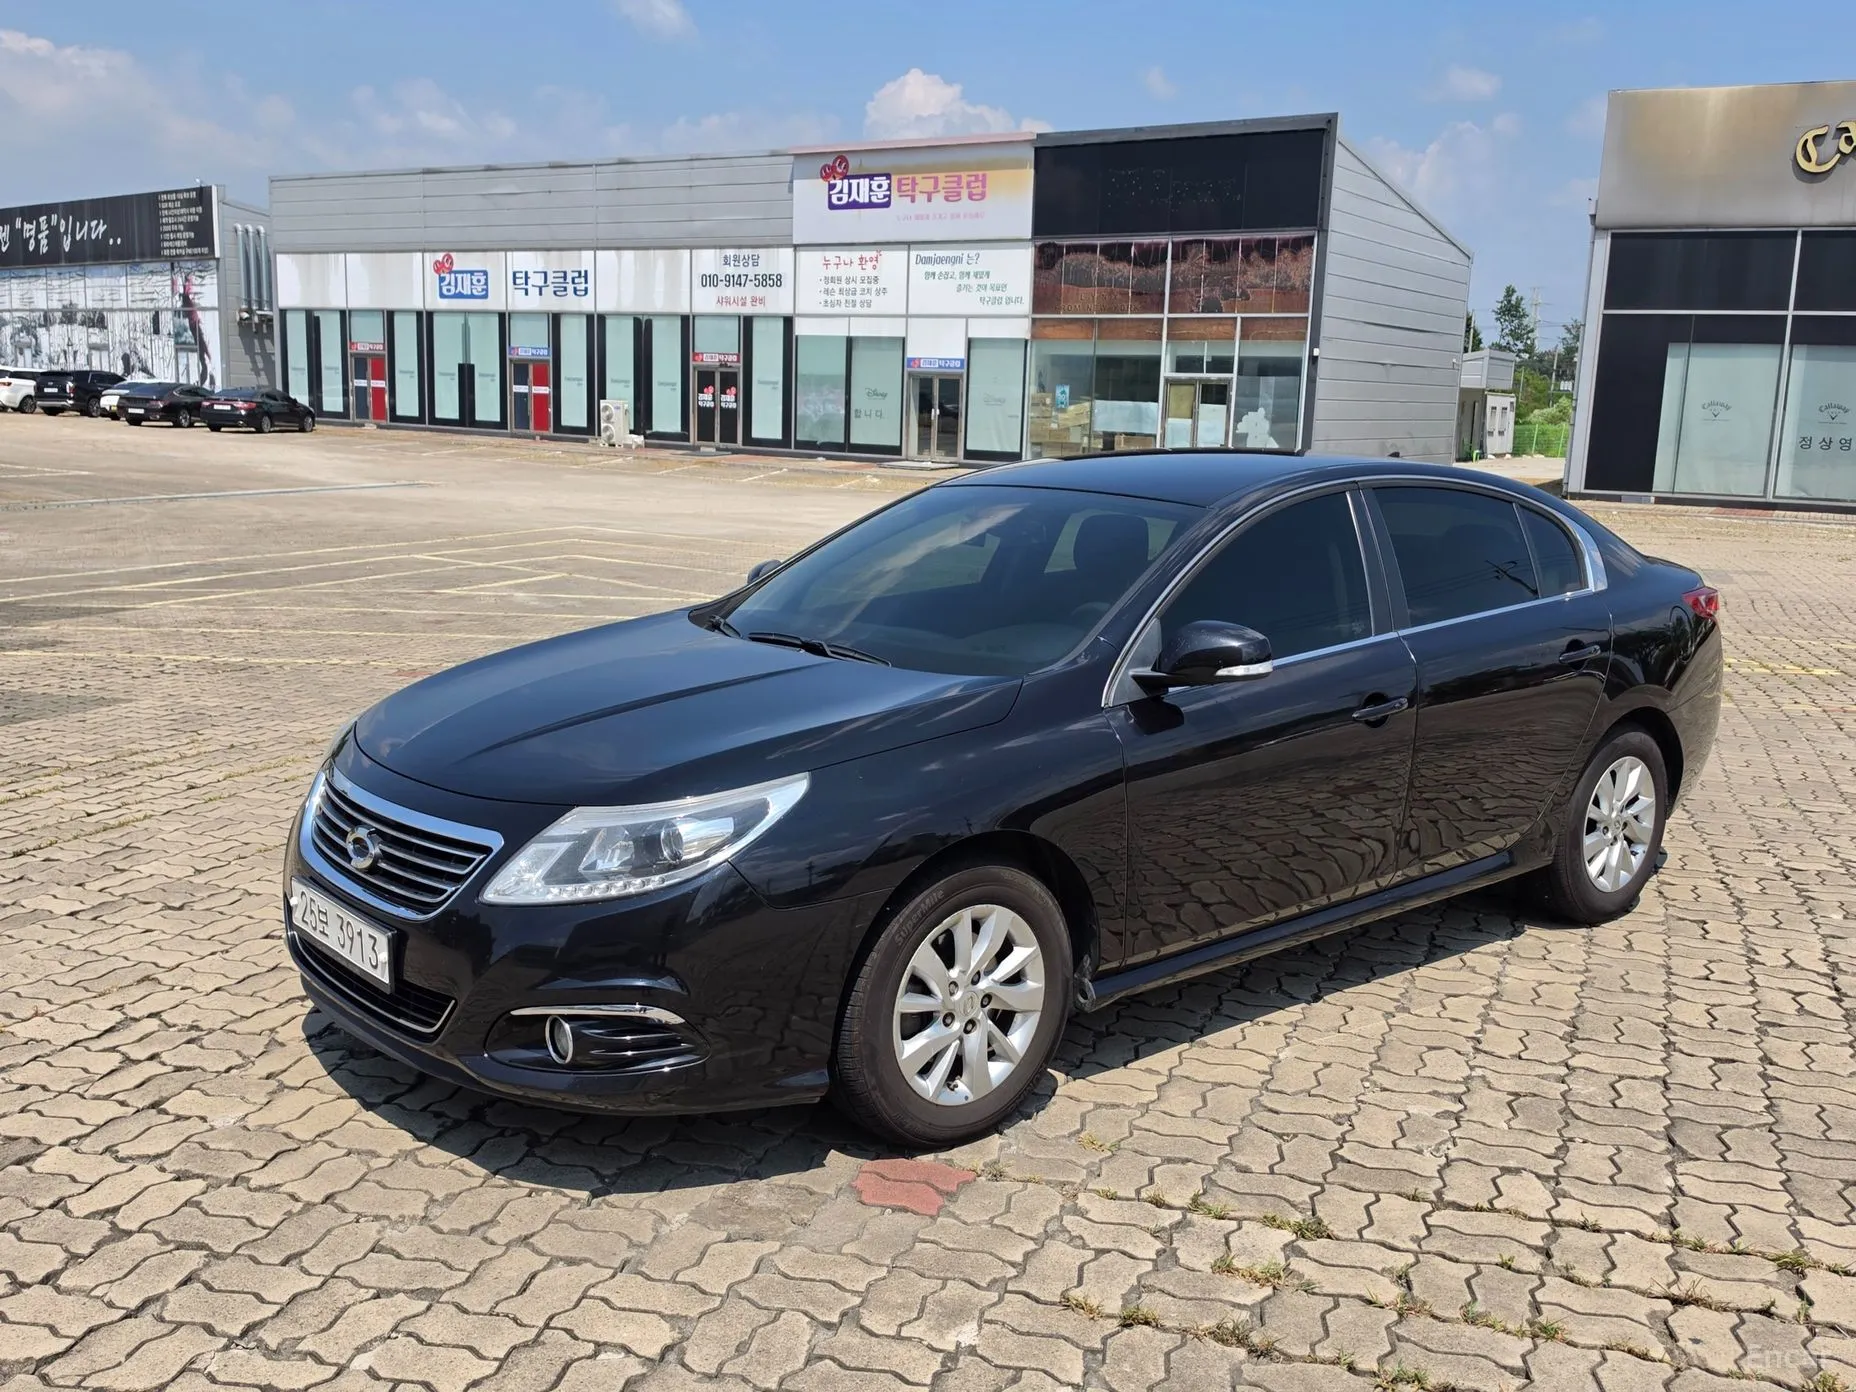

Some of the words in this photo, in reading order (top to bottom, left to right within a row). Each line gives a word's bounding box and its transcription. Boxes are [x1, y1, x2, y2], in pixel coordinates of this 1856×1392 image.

[829, 176, 891, 205] 김재훈
[897, 173, 987, 204] 탁구클럽
[722, 254, 760, 268] 회원상담
[823, 255, 854, 270] 누구나
[858, 254, 879, 271] 환영
[915, 253, 964, 266] Damjaengni
[440, 272, 487, 296] 김재훈
[512, 269, 589, 297] 탁구클럽
[701, 273, 783, 288] 010-9147-5858
[845, 275, 858, 286] 상시
[859, 275, 880, 285] 모집중
[1819, 402, 1850, 414] Callaway
[336, 913, 379, 970] 3913
